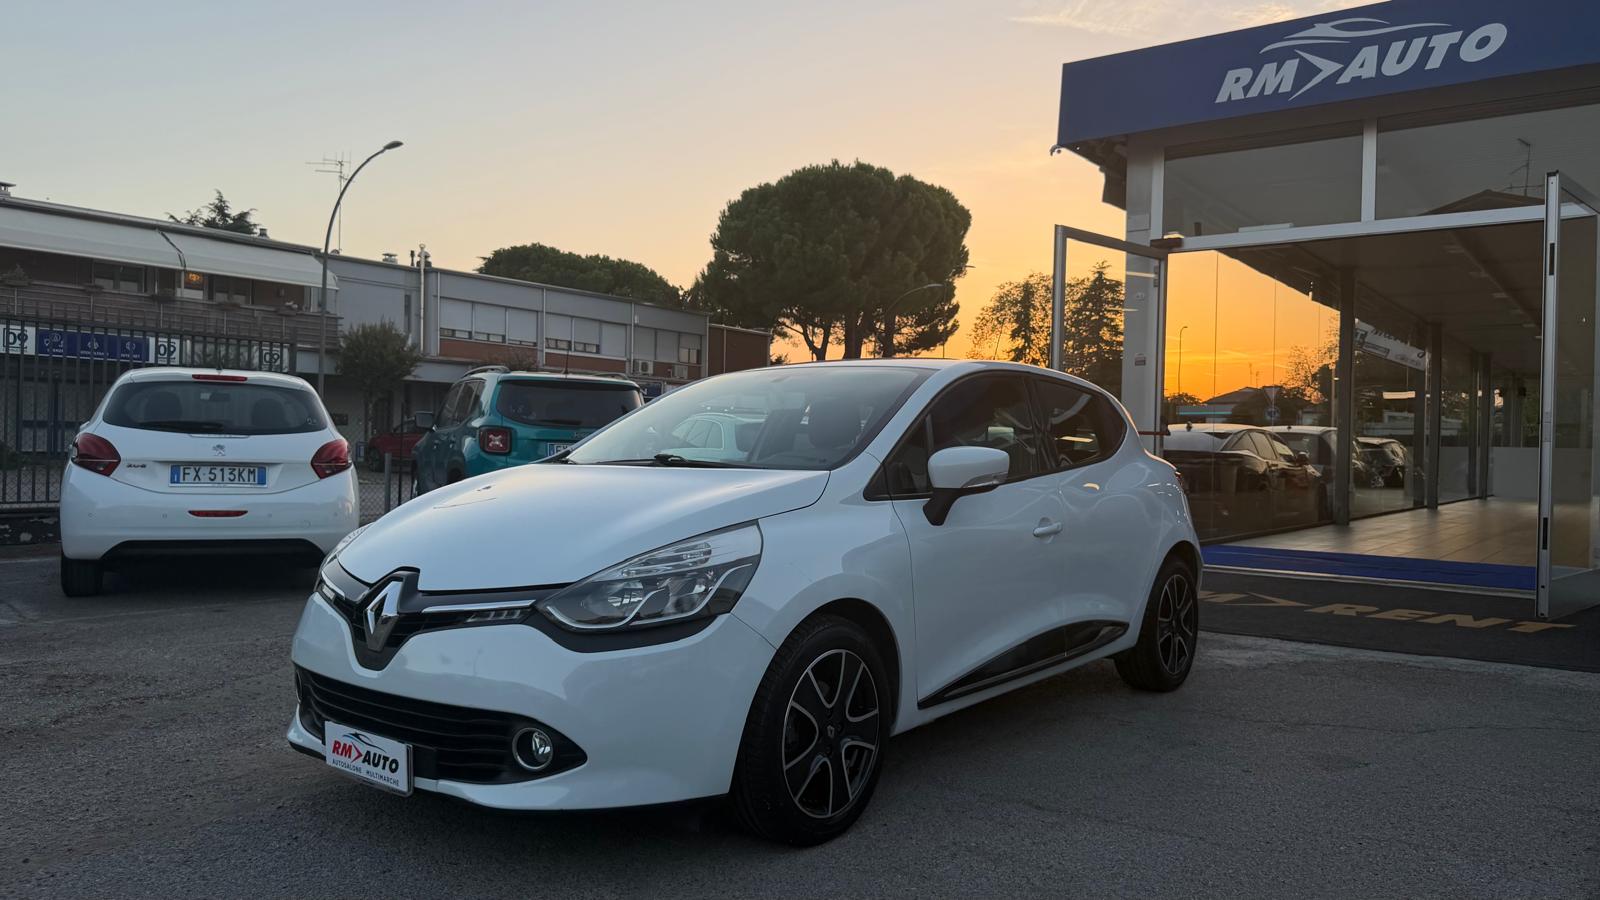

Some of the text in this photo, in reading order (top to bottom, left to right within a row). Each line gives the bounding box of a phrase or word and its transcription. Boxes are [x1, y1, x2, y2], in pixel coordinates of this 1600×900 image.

[1214, 22, 1508, 103] RM AUTO
[182, 466, 201, 481] FX
[208, 467, 256, 483] 513KM
[1303, 603, 1577, 634] RENT
[331, 740, 399, 774] RM AUTO
[332, 758, 400, 786] AUTOSALONE MULTIMARCHE
